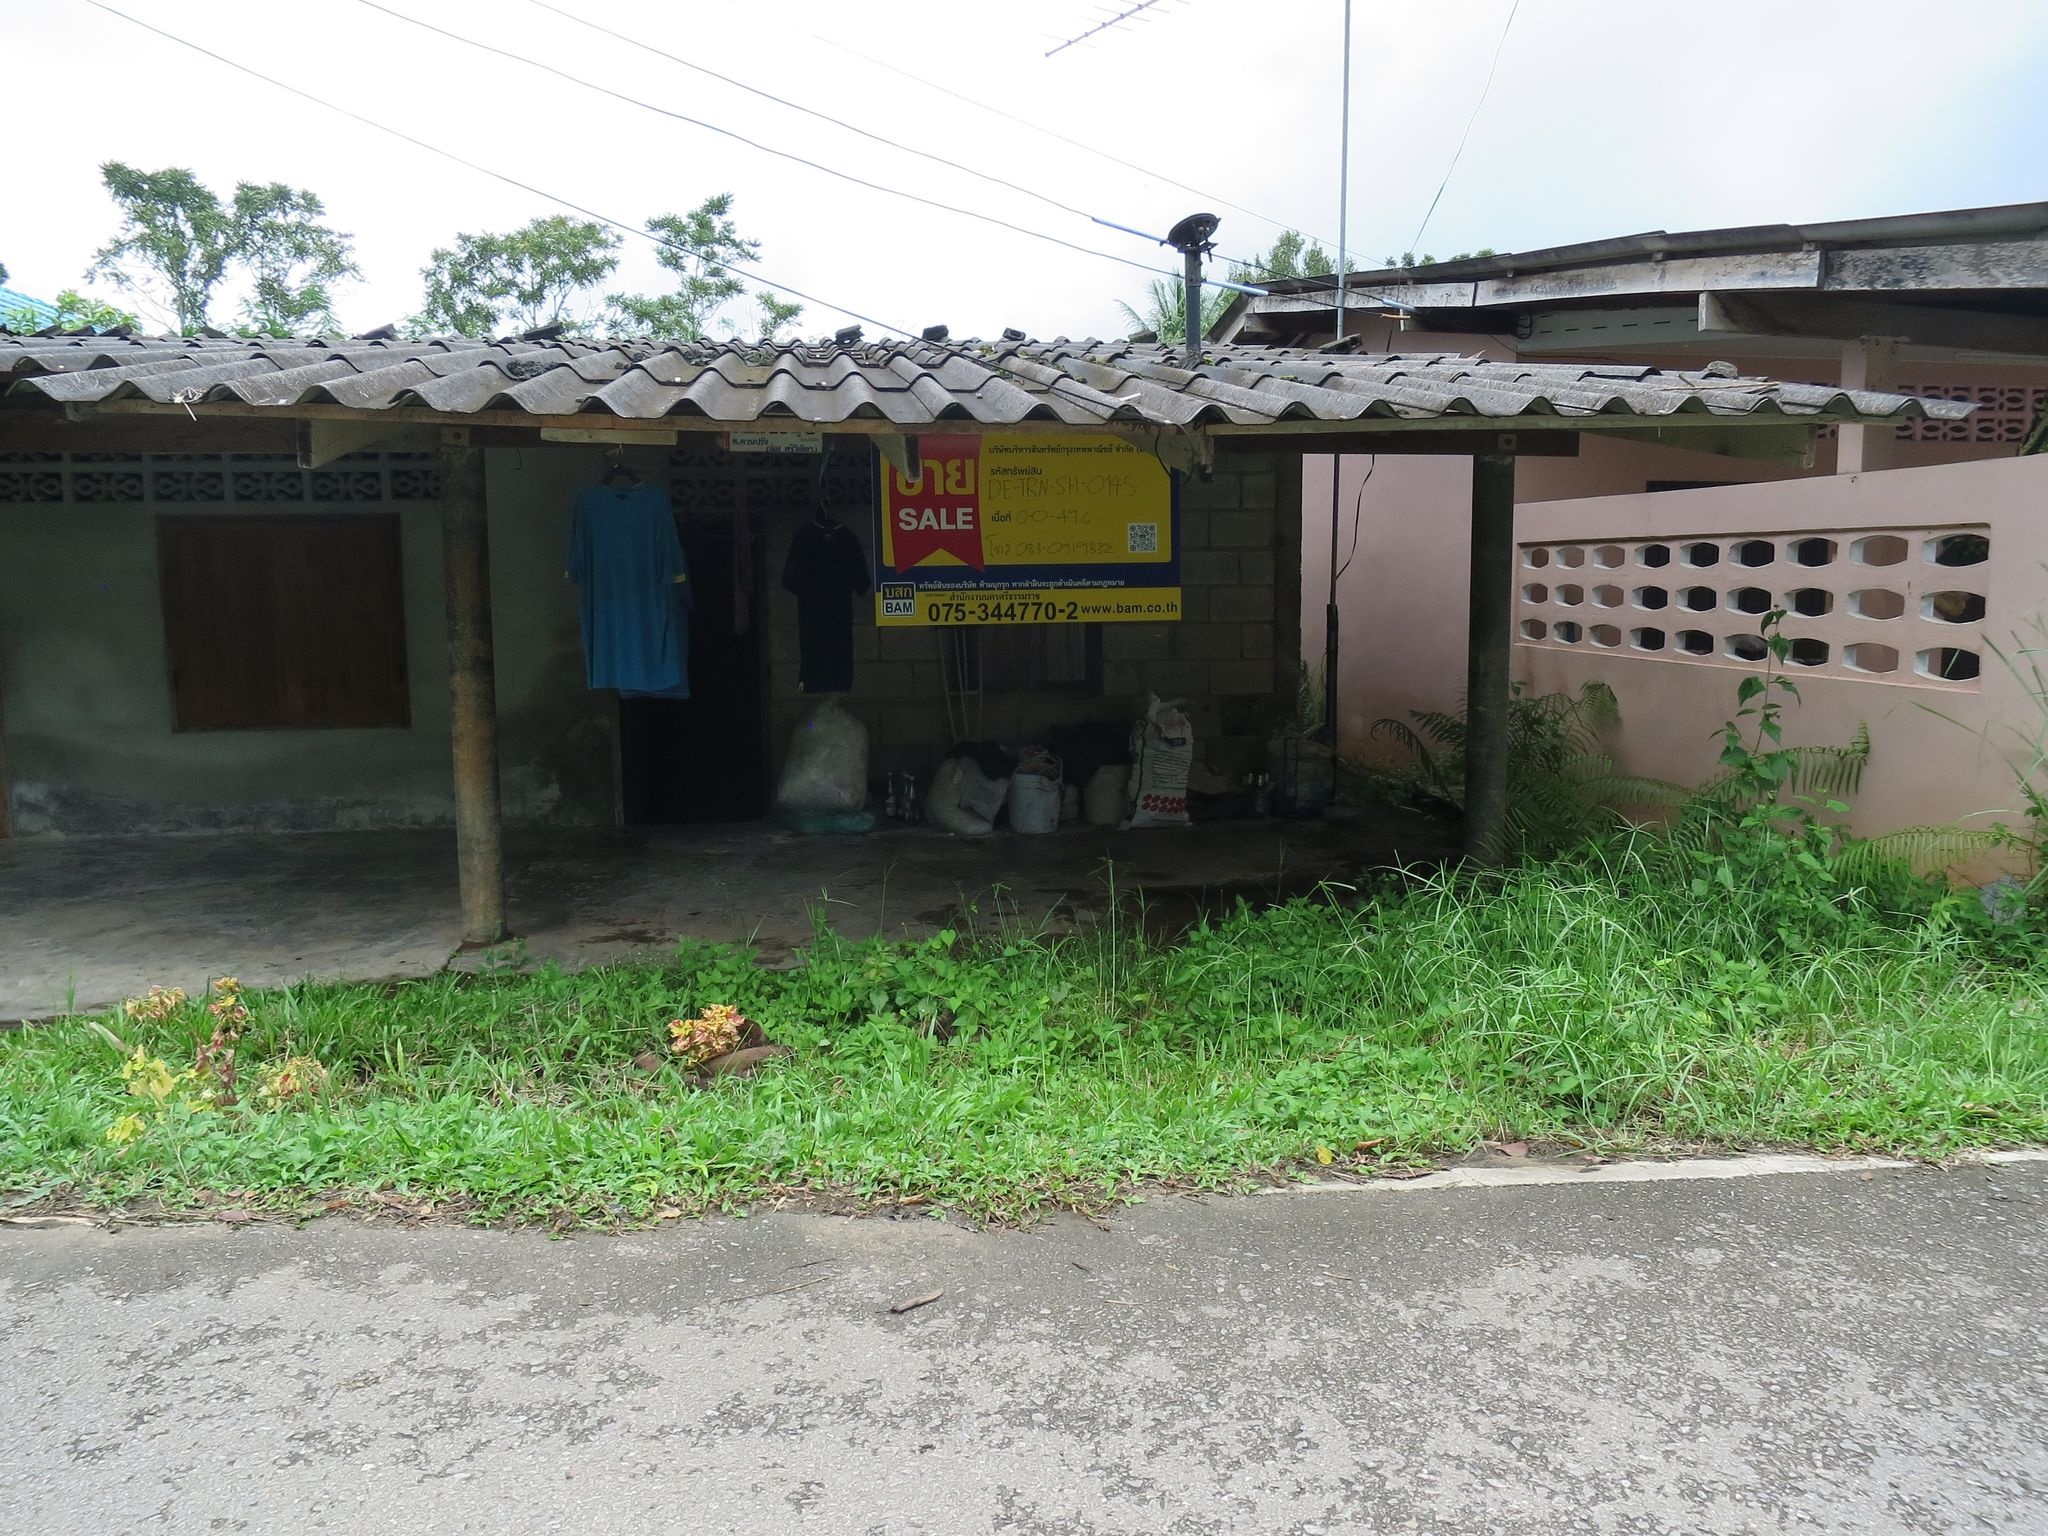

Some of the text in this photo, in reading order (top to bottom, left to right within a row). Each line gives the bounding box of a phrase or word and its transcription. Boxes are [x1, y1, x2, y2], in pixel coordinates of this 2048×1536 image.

[990, 466, 1042, 476] รหัสทรัพย์สิน
[898, 507, 974, 530] SALE
[884, 586, 912, 598] บสก
[949, 591, 1040, 602] สำนักงานนครศรีธรรมราช
[885, 602, 912, 613] BAM
[928, 600, 1178, 622] 075-344770-2 www.bam.co.th
